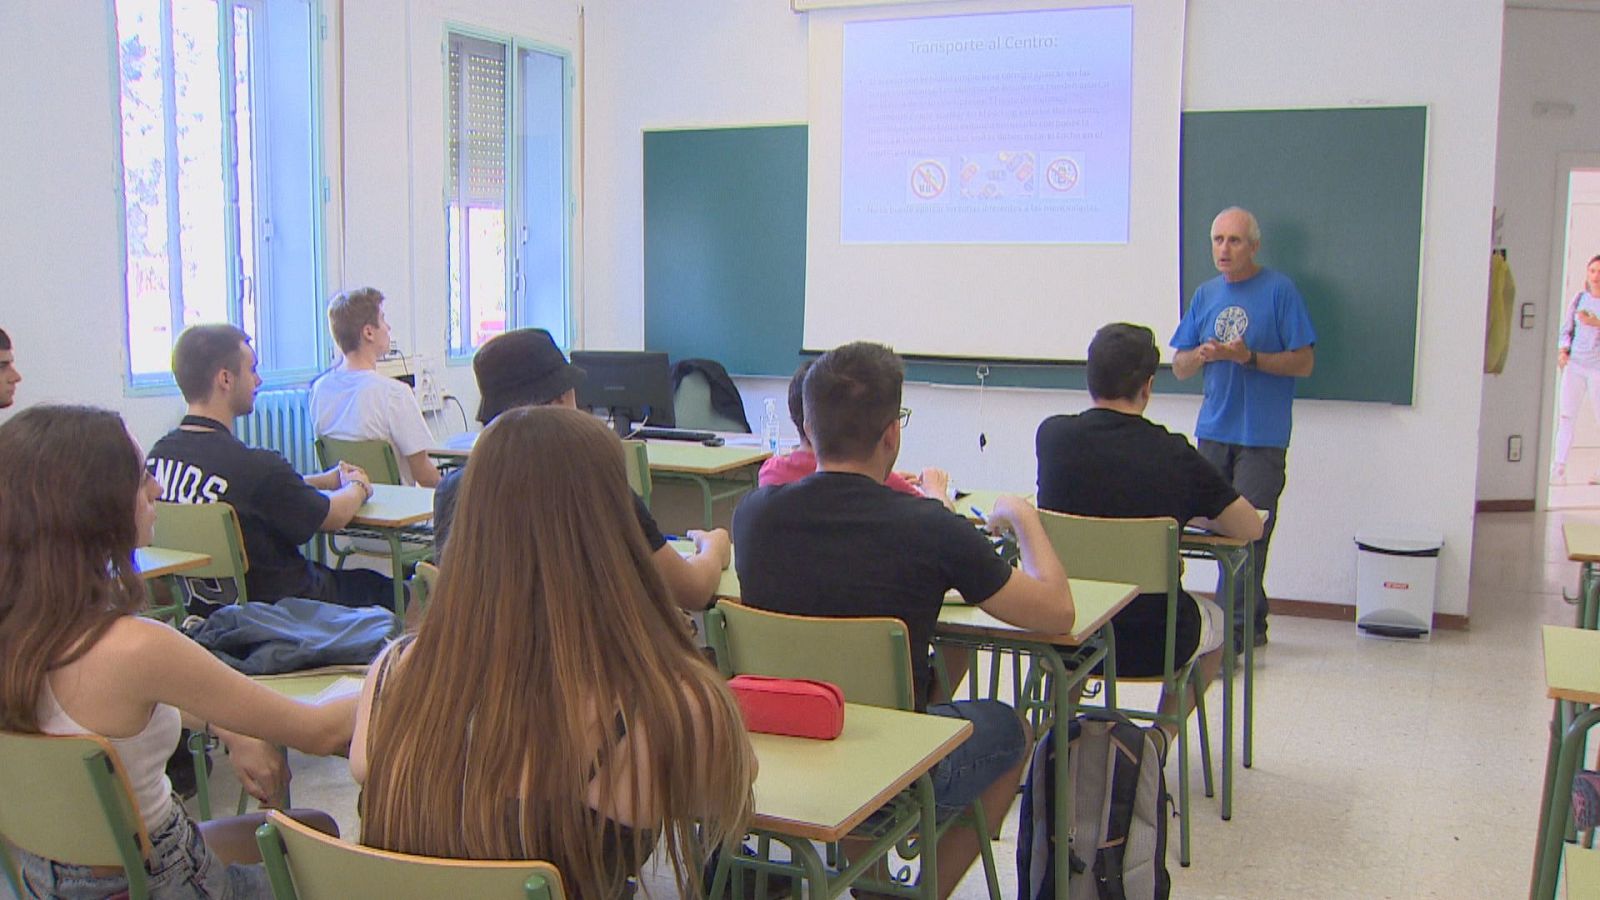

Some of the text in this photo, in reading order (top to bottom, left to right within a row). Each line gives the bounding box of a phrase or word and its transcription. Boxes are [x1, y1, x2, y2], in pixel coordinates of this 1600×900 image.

[909, 34, 1059, 56] Transporte al Centro:
